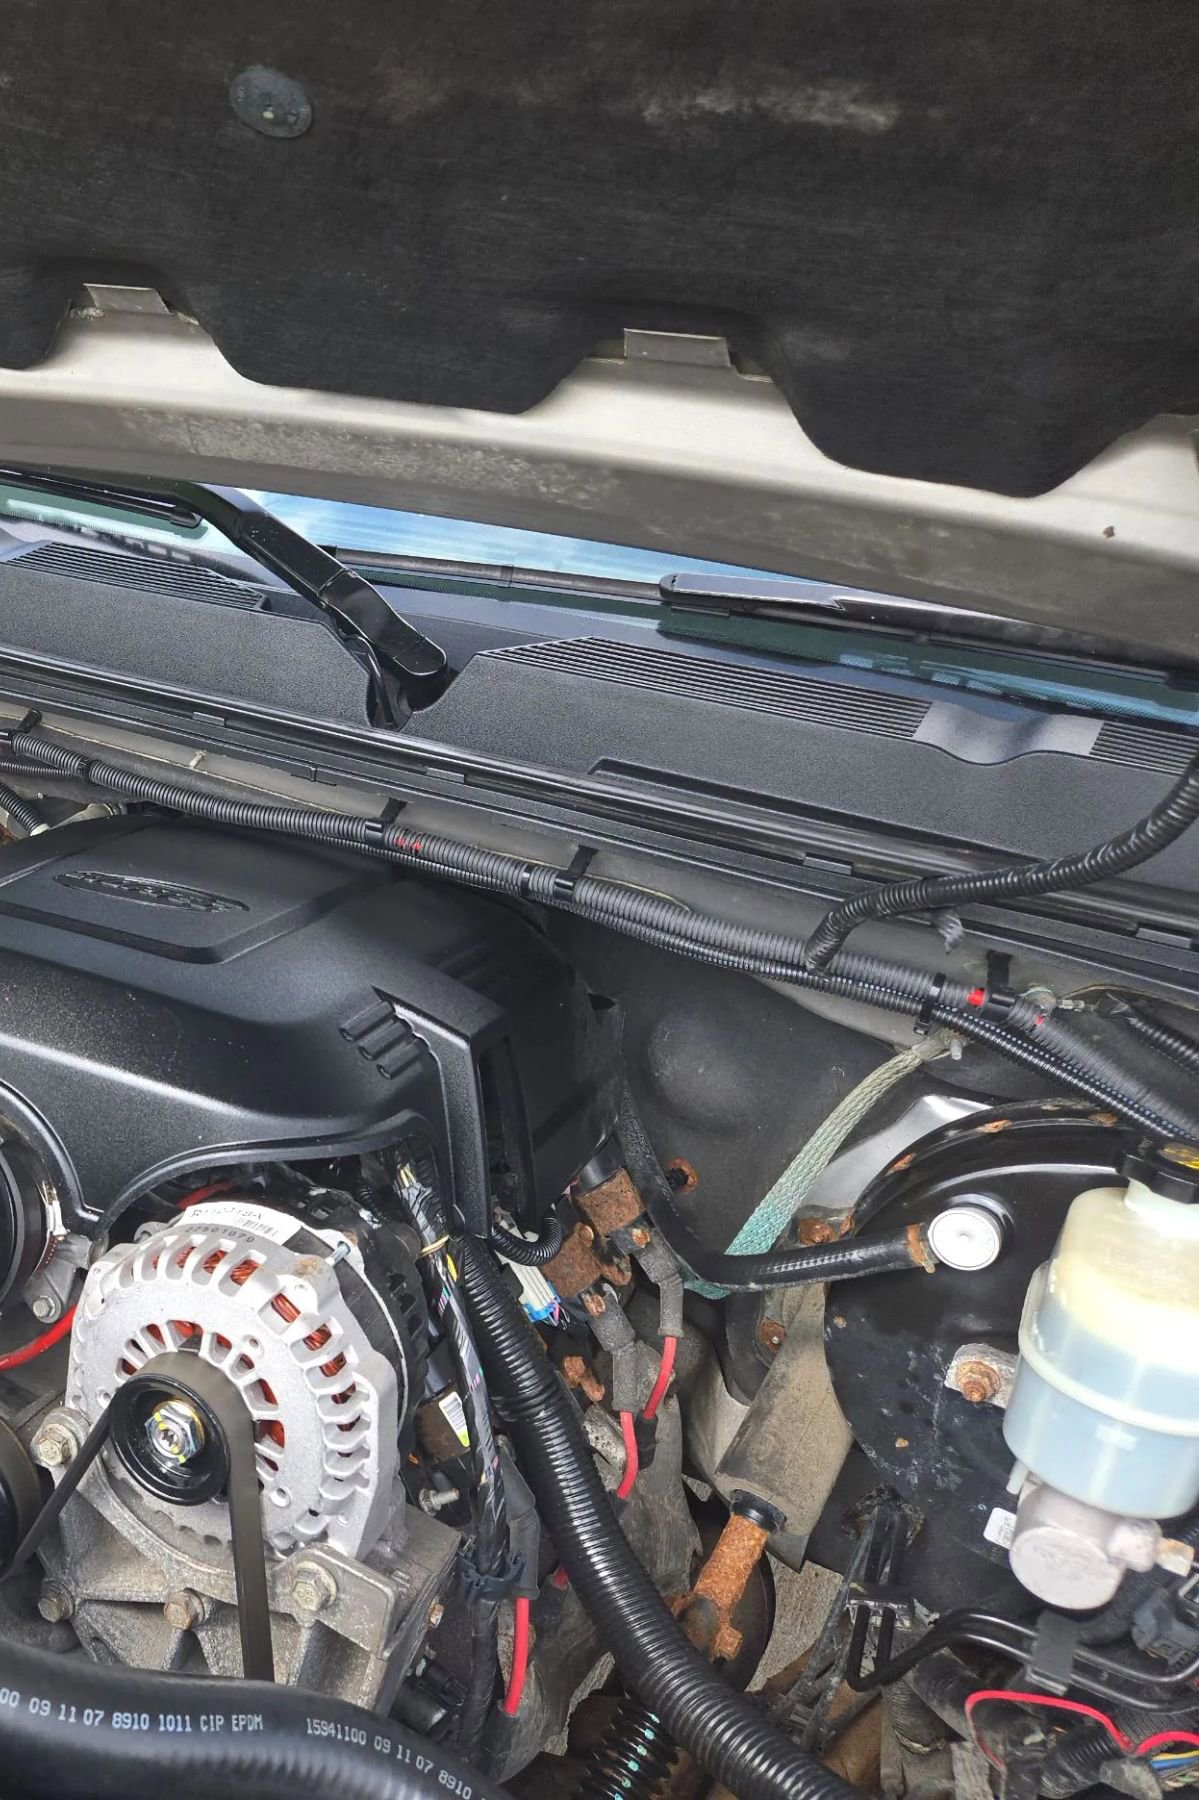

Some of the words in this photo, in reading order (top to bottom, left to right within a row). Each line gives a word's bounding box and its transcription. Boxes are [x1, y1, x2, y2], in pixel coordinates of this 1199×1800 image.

[28, 1697, 51, 1717] 09
[58, 1703, 77, 1723] 11
[82, 1708, 105, 1727] 07
[111, 1711, 150, 1731] 8910
[158, 1714, 193, 1732] 1011
[199, 1714, 225, 1733] CIP
[231, 1713, 264, 1732] EPDM
[306, 1717, 367, 1746] 15941100
[373, 1735, 391, 1754] 09
[396, 1744, 411, 1764] 11
[415, 1755, 435, 1774] 07
[437, 1769, 473, 1800] 8910
